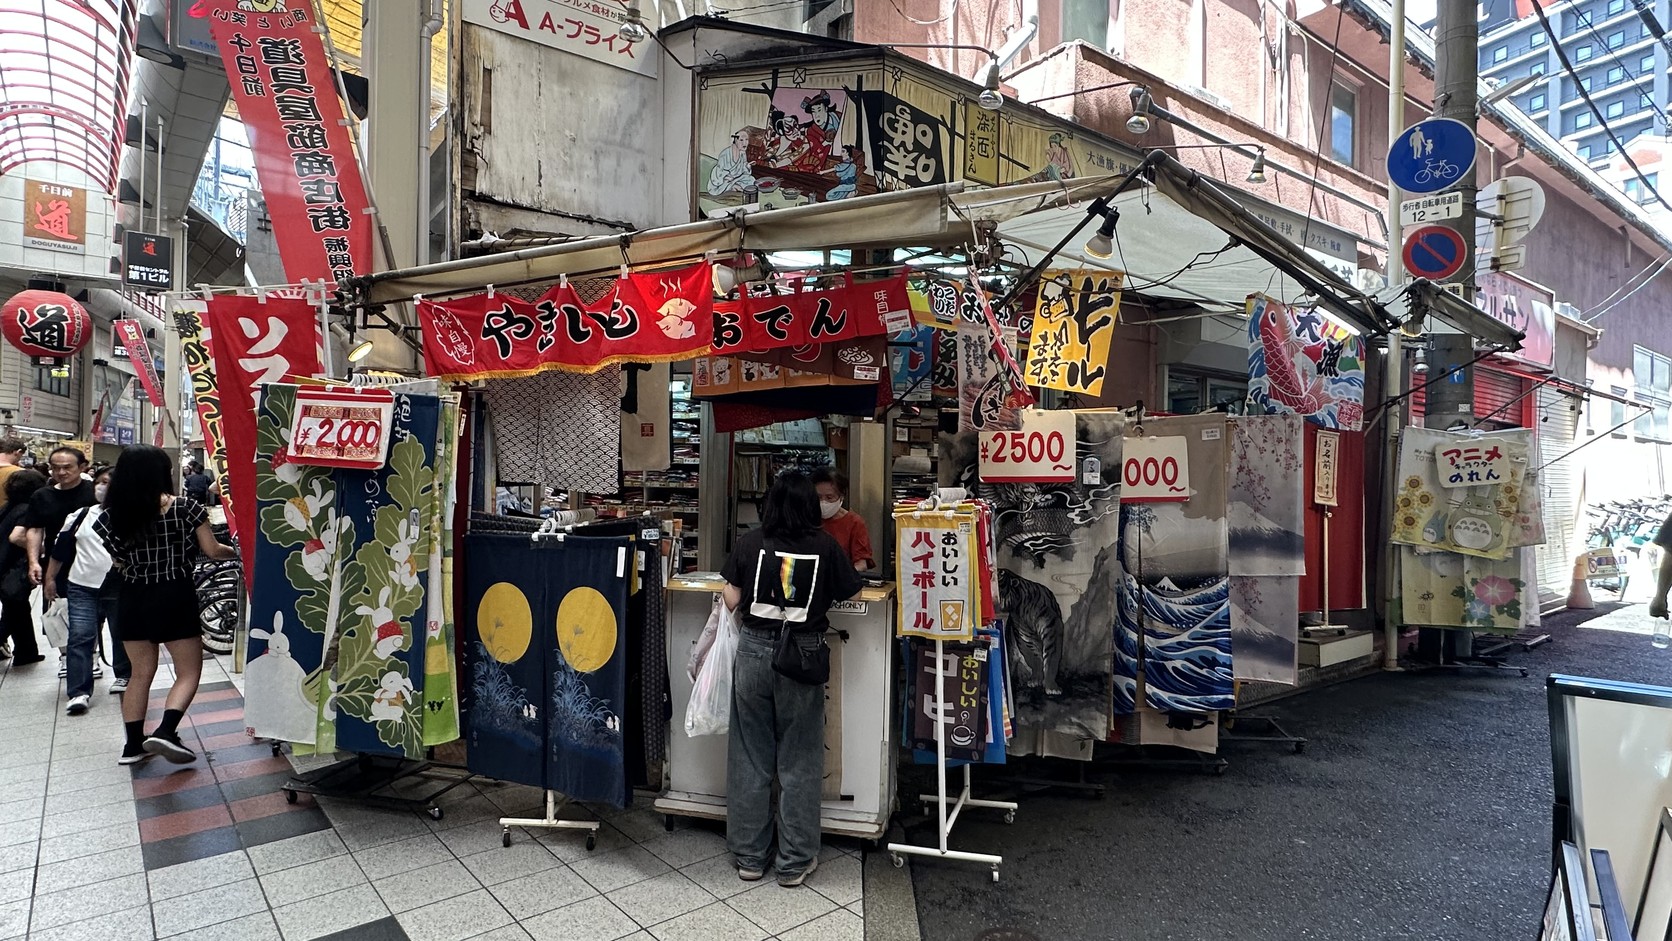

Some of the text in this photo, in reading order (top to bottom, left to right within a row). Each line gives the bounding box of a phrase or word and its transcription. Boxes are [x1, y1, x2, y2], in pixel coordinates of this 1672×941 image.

[538, 10, 636, 59] A-プライス
[38, 184, 74, 198] 千日前
[34, 200, 78, 240] 道
[1412, 210, 1426, 222] 12
[31, 239, 78, 250] DOGUYASUJI
[128, 271, 170, 283] 第1ビル
[18, 304, 77, 352] 道
[713, 297, 847, 349] おでん
[1067, 276, 1114, 390] ビール
[1296, 314, 1345, 377] 大漁
[1415, 455, 1436, 463] TOTO
[1442, 445, 1503, 466] アニメ
[1454, 461, 1494, 470] キャラクター
[1449, 468, 1501, 483] のれん
[942, 532, 959, 587] おいしい
[911, 531, 936, 629] ハイボール
[845, 602, 863, 610] ONLY
[960, 655, 978, 707] おいしい
